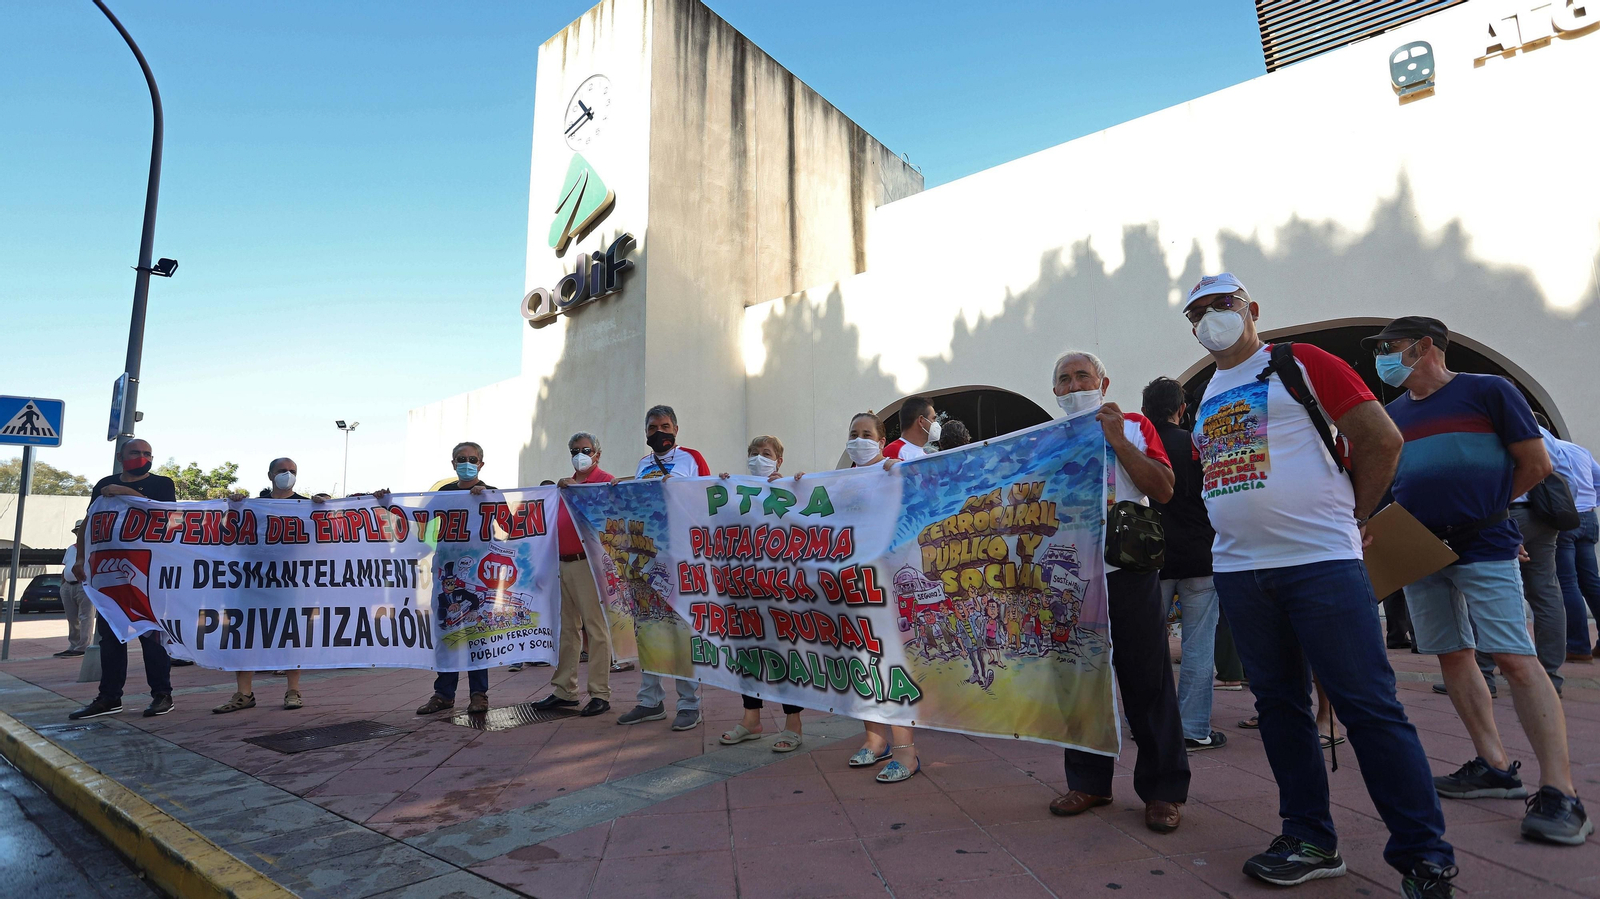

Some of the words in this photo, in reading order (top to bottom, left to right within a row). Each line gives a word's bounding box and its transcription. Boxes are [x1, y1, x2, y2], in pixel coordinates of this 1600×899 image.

[520, 232, 636, 321] adif
[1227, 449, 1256, 458] PTRA
[1249, 453, 1266, 463] EN
[1221, 471, 1268, 487] RURAL
[1236, 463, 1257, 473] DEL
[706, 484, 835, 519] PTRA
[1007, 481, 1046, 504] UN
[1207, 481, 1266, 499] ANDALUCÍA
[91, 510, 119, 544] EN
[119, 507, 258, 545] DEFENSA
[265, 515, 310, 544] DEL
[310, 505, 409, 543] EMPLEO
[413, 510, 429, 542] Y
[433, 509, 471, 542] DEL
[479, 499, 546, 541] TREN
[918, 500, 1060, 546] FERROCARRIL
[688, 525, 855, 563] PLATAFORMA
[1017, 533, 1043, 559] Y
[158, 566, 182, 589] NI
[483, 560, 514, 582] STOP
[678, 561, 708, 596] EN
[711, 563, 818, 602] DEFENSA
[818, 564, 885, 606] DEL
[940, 562, 1050, 596] SOCIAL
[196, 597, 433, 650] PRIVATIZACIÓN
[689, 601, 765, 641] TREN
[768, 606, 882, 656] RURAL
[469, 638, 487, 649] POR
[490, 634, 503, 643] UN
[470, 643, 515, 662] PÚBLICO
[519, 642, 525, 651] Y
[691, 636, 719, 668] EN
